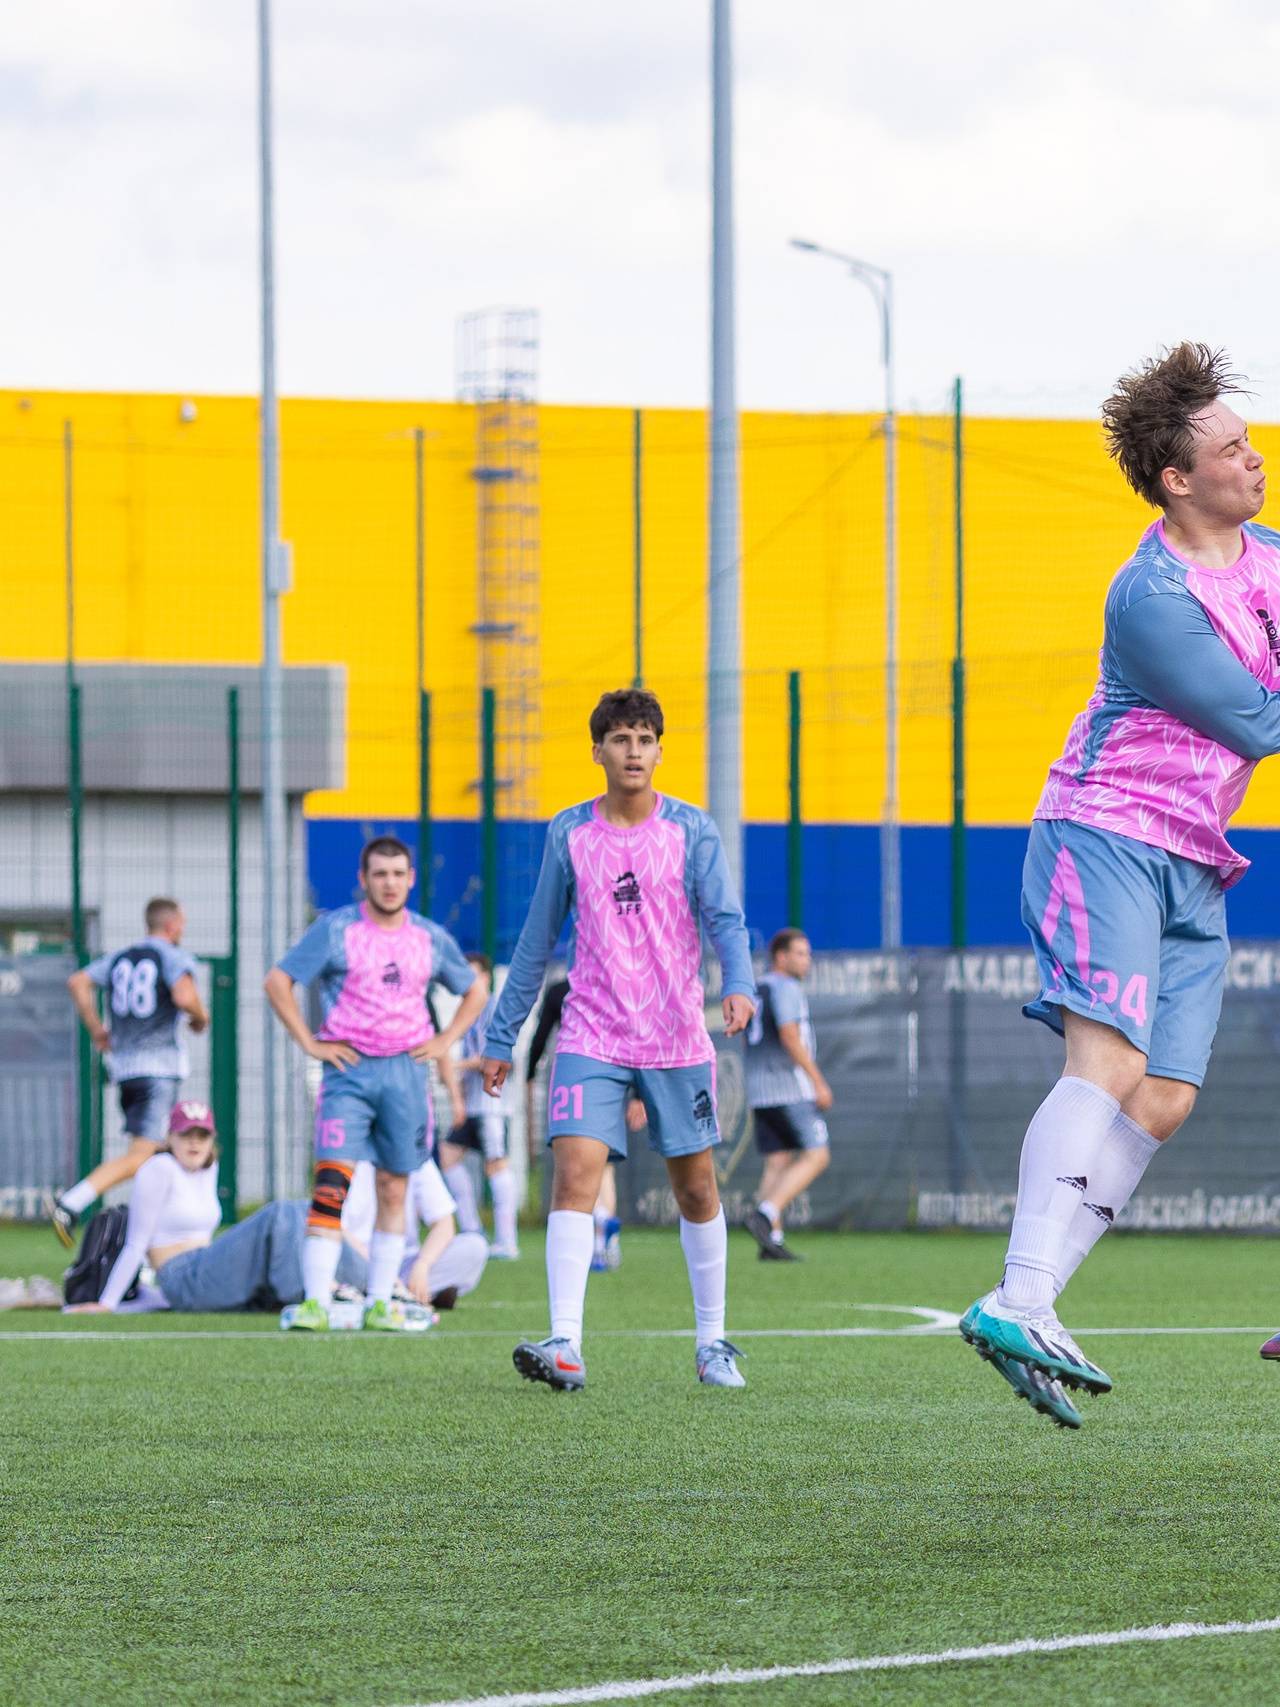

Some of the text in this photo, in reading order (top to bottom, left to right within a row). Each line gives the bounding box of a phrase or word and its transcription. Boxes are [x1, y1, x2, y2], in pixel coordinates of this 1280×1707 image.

[111, 956, 158, 1019] 88
[943, 954, 1042, 1000] АКАДЕ
[1091, 969, 1147, 1027] 24
[552, 1084, 583, 1121] 21
[321, 1118, 346, 1149] 15
